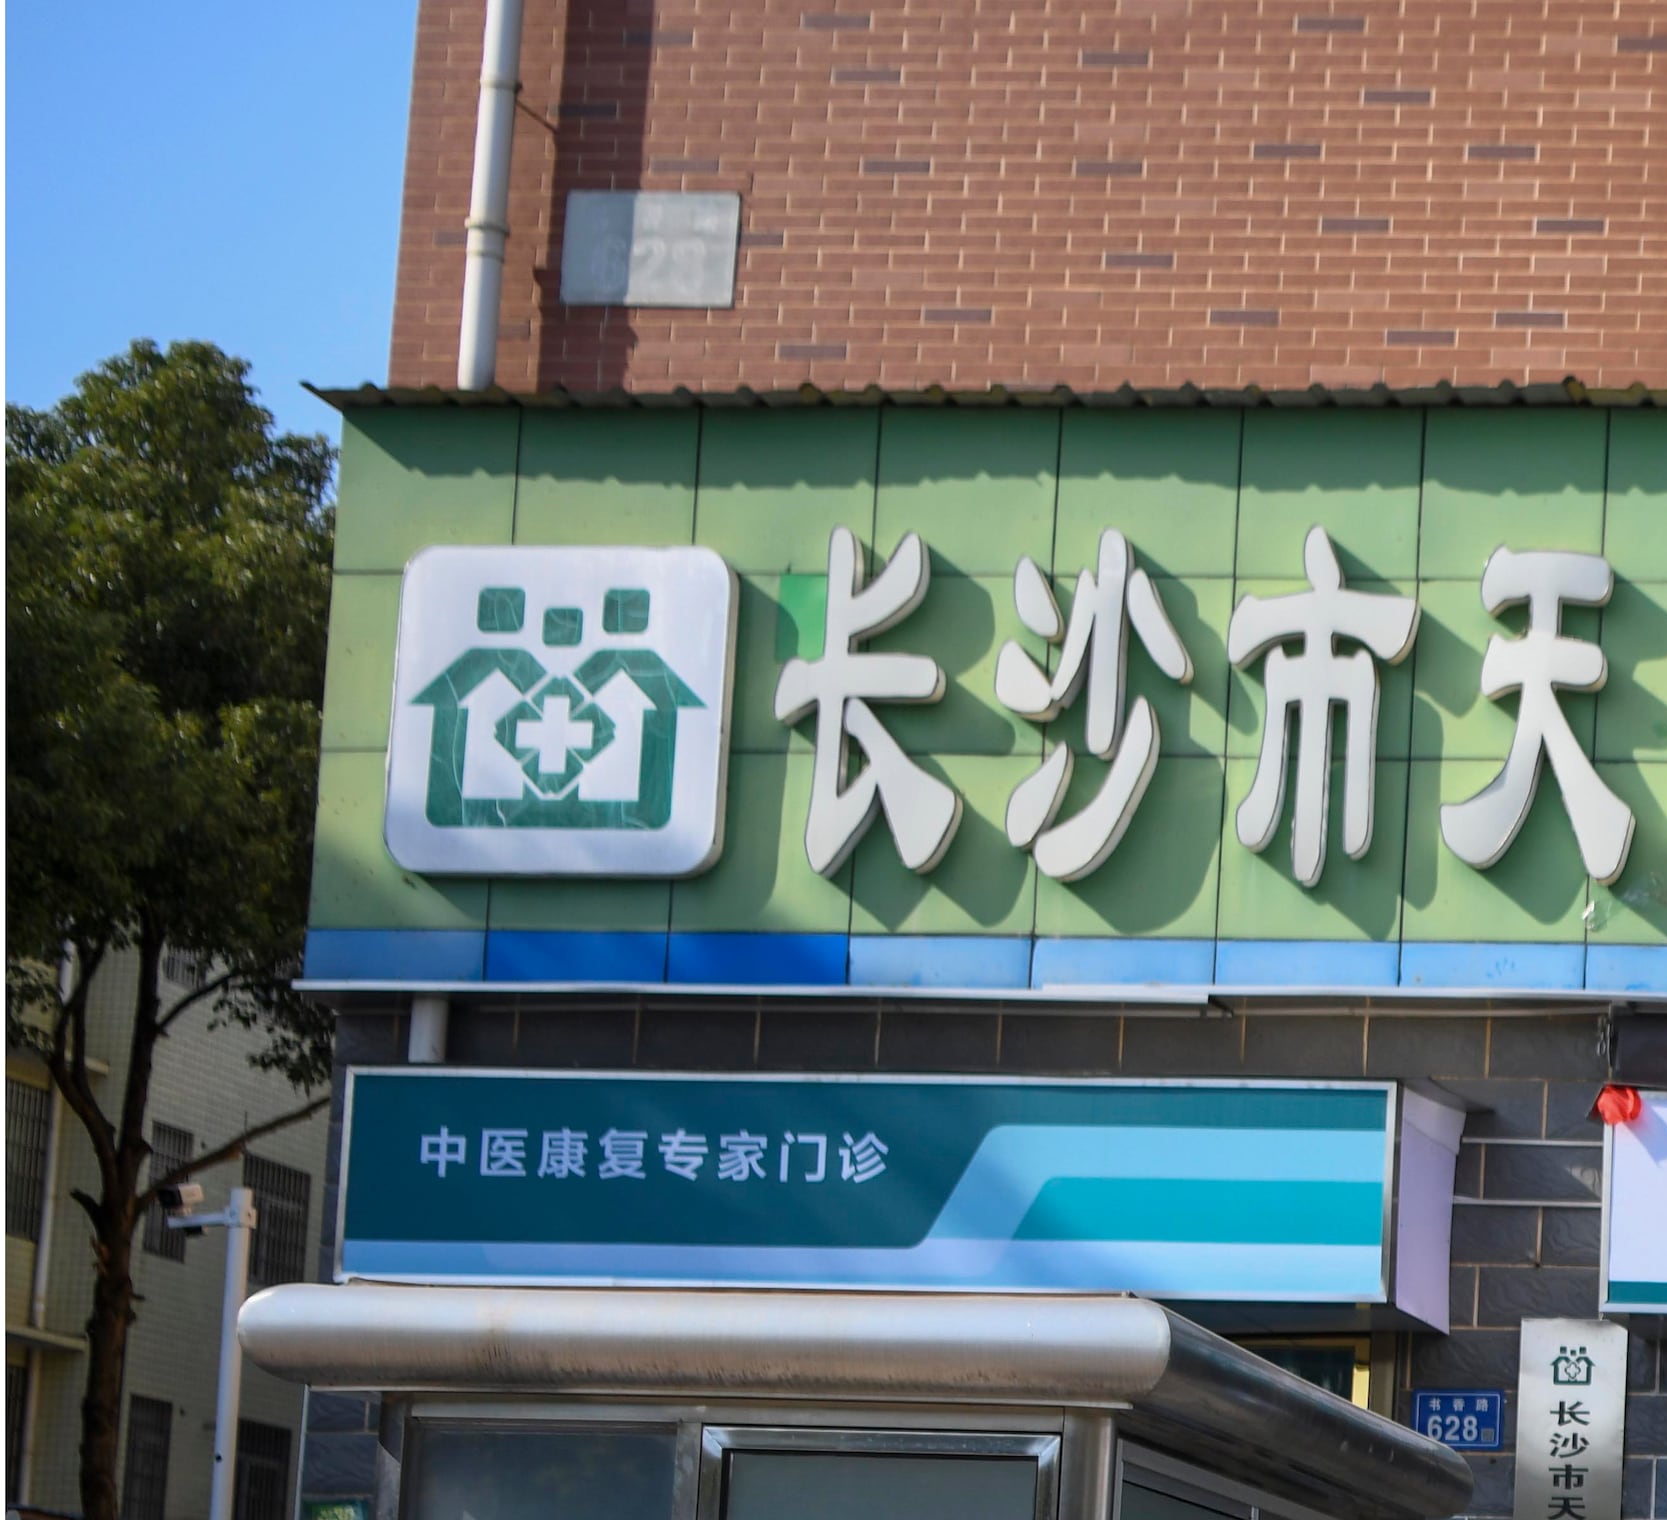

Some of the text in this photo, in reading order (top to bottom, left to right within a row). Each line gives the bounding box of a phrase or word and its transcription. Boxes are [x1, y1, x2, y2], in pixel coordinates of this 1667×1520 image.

[419, 1124, 891, 1185] 中医康复专家门诊
[1427, 1415, 1479, 1441] 628
